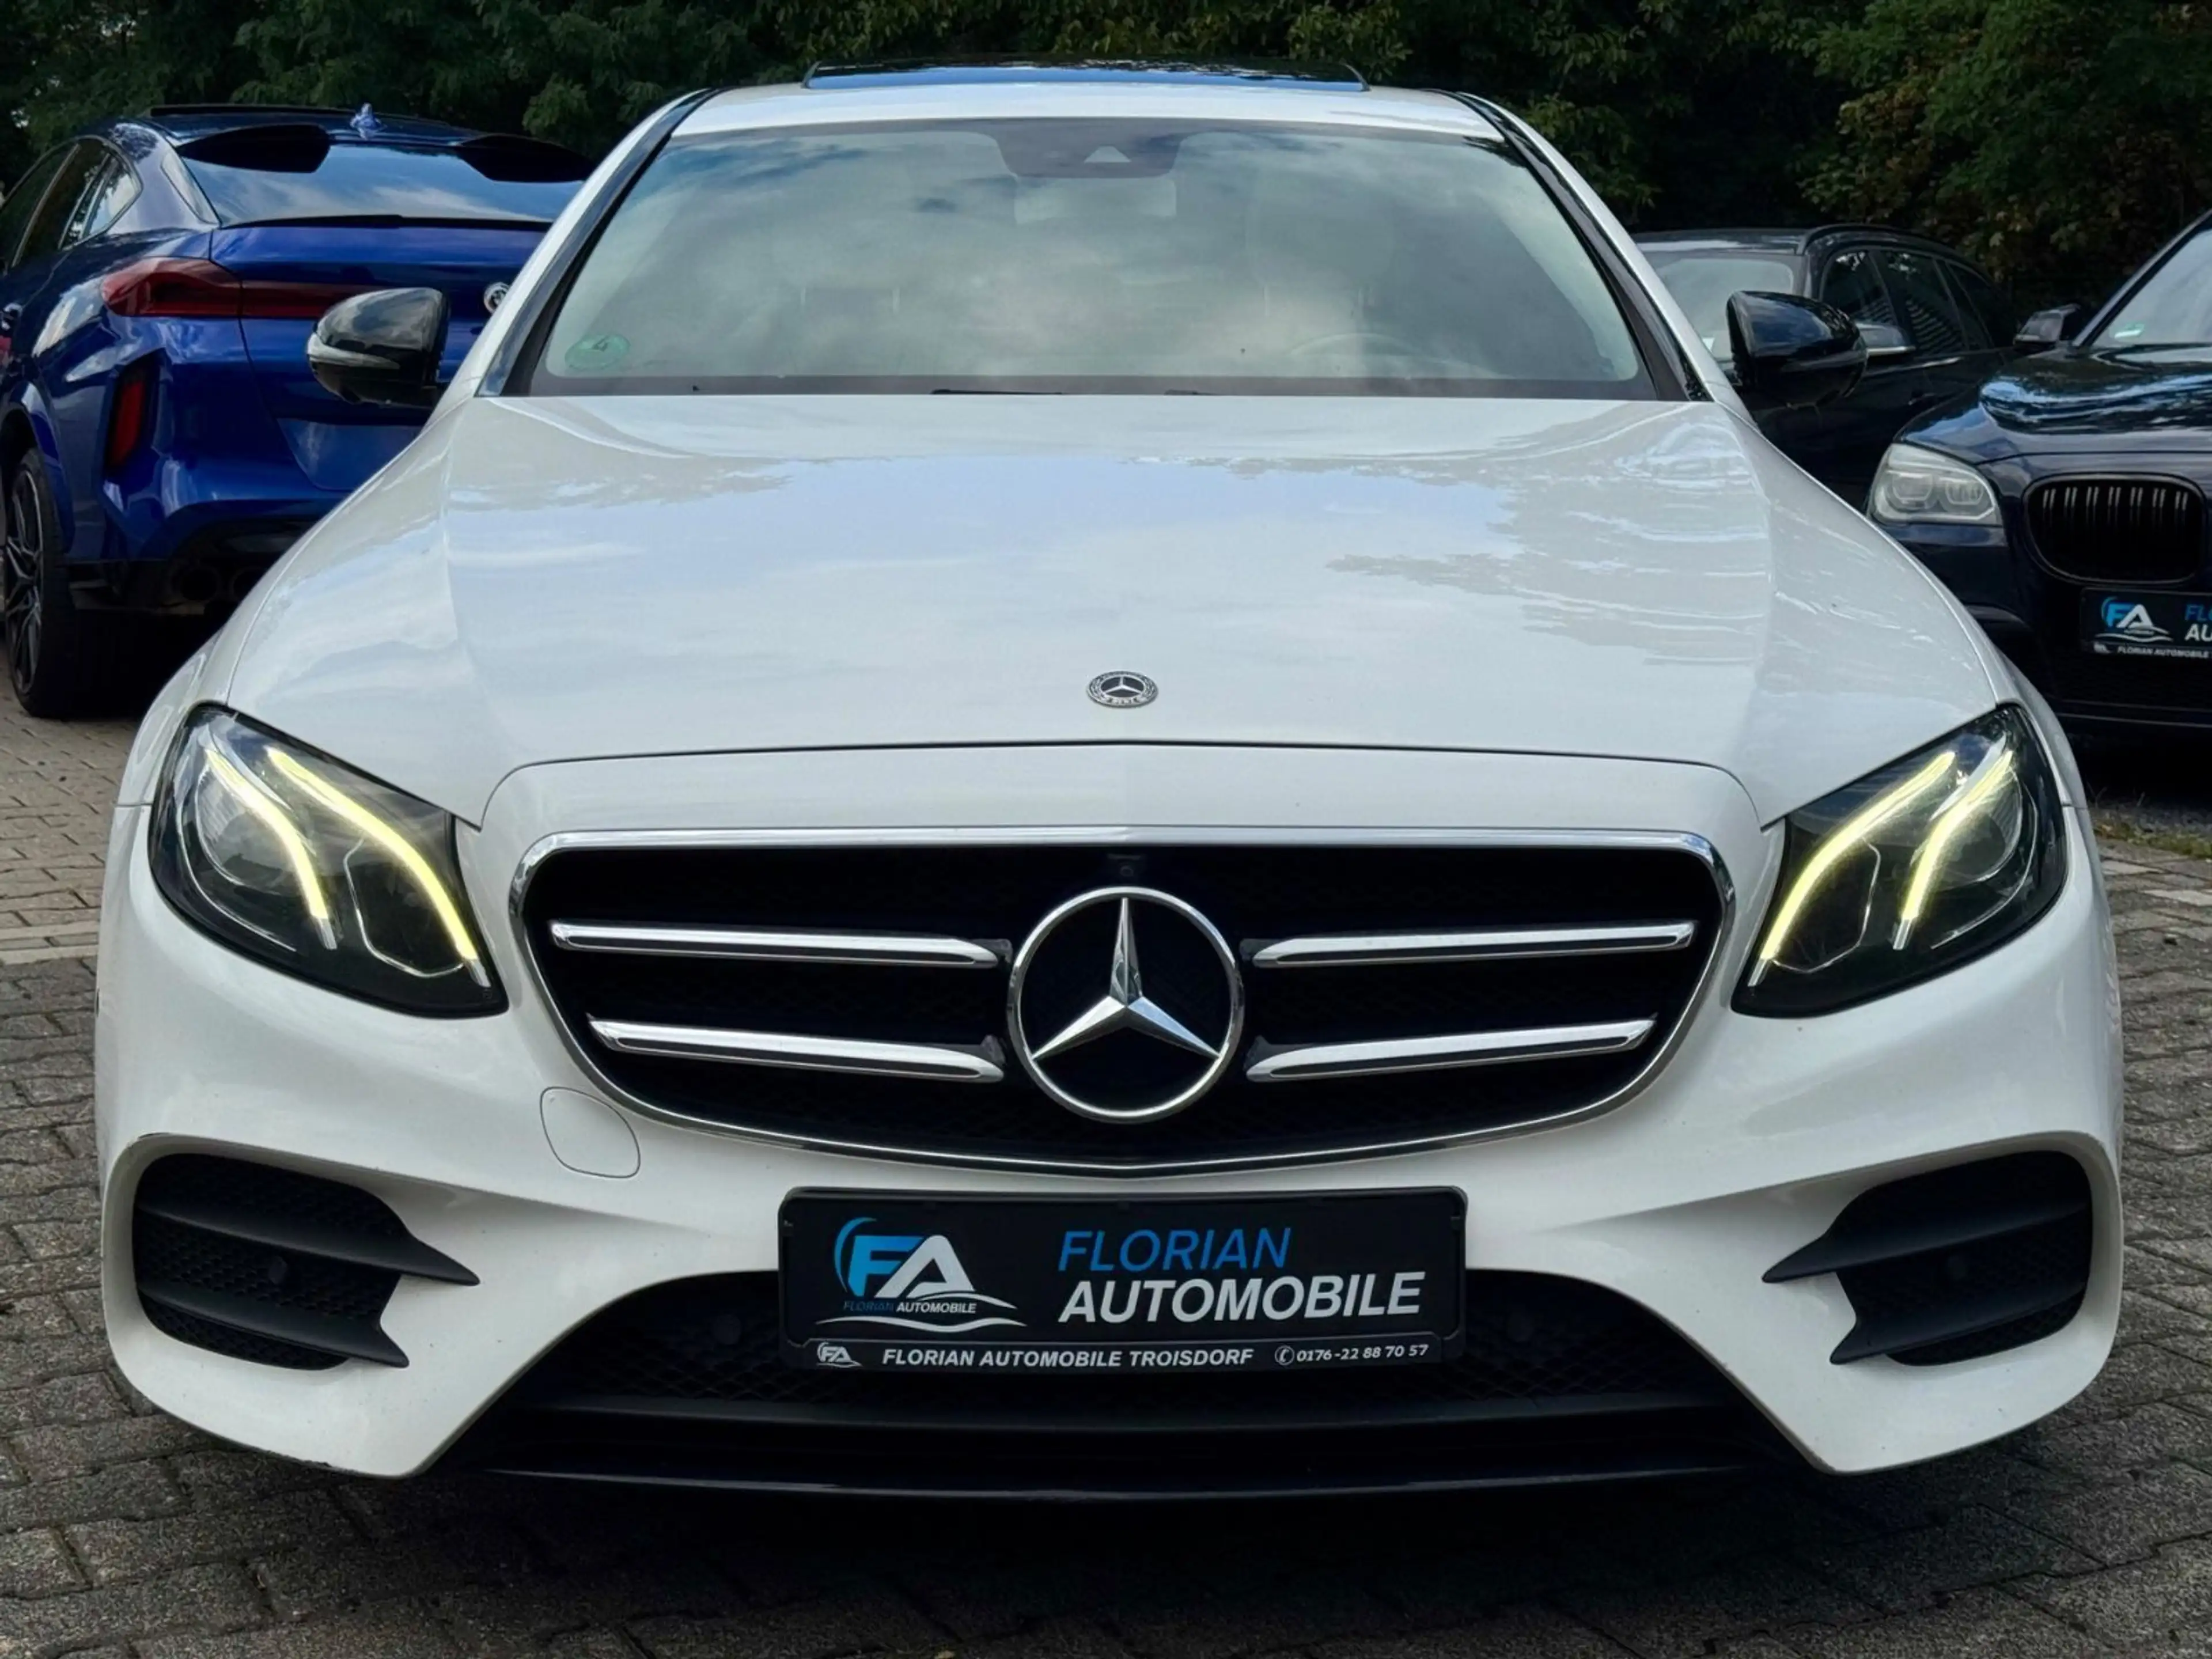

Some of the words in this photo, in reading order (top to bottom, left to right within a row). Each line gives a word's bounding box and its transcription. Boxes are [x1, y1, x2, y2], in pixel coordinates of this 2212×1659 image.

[1058, 1227, 1291, 1271] FLORIAN
[848, 1234, 976, 1298] FA
[896, 1301, 978, 1314] AUTOMOBILE
[1058, 1271, 1426, 1323] AUTOMOBILE
[881, 1349, 975, 1366] FLORIAN
[979, 1349, 1123, 1368] AUTOMOBILE
[1128, 1349, 1255, 1367] TROISDORF
[1362, 1346, 1381, 1359] 88
[1384, 1344, 1405, 1358] 70
[1408, 1343, 1429, 1357] 57
